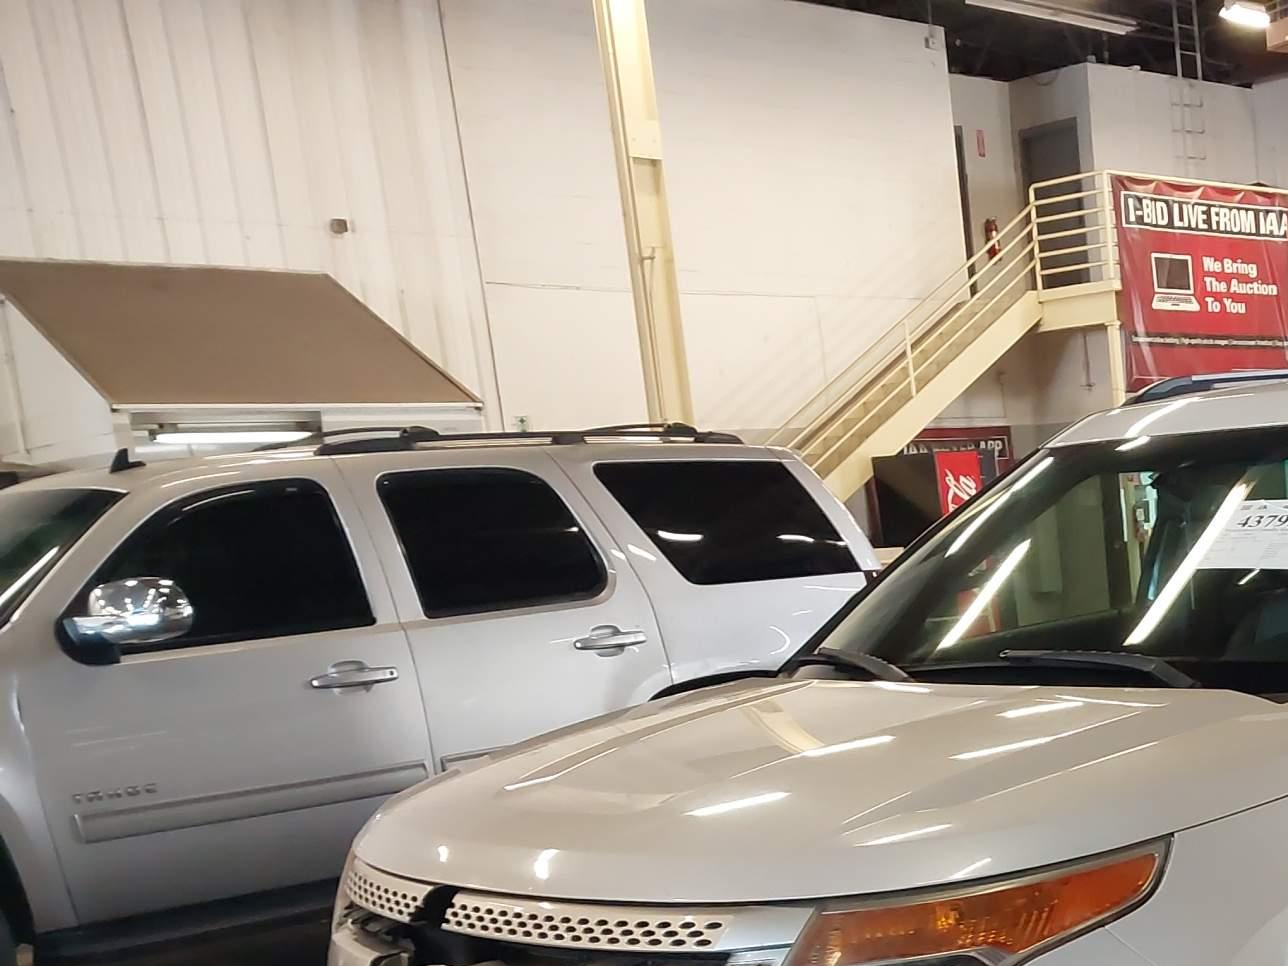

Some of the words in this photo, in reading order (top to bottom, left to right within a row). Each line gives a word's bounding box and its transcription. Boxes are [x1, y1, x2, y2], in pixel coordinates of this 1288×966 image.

[1127, 197, 1169, 226] I-BID
[1173, 203, 1208, 230] LIVE
[1211, 206, 1256, 234] FROM
[1260, 211, 1288, 236] IAA
[1202, 256, 1222, 272] We
[1223, 258, 1257, 278] Bring
[1204, 276, 1228, 292] The
[1230, 278, 1278, 295] Auction
[1204, 297, 1221, 312] To
[1223, 298, 1246, 313] You
